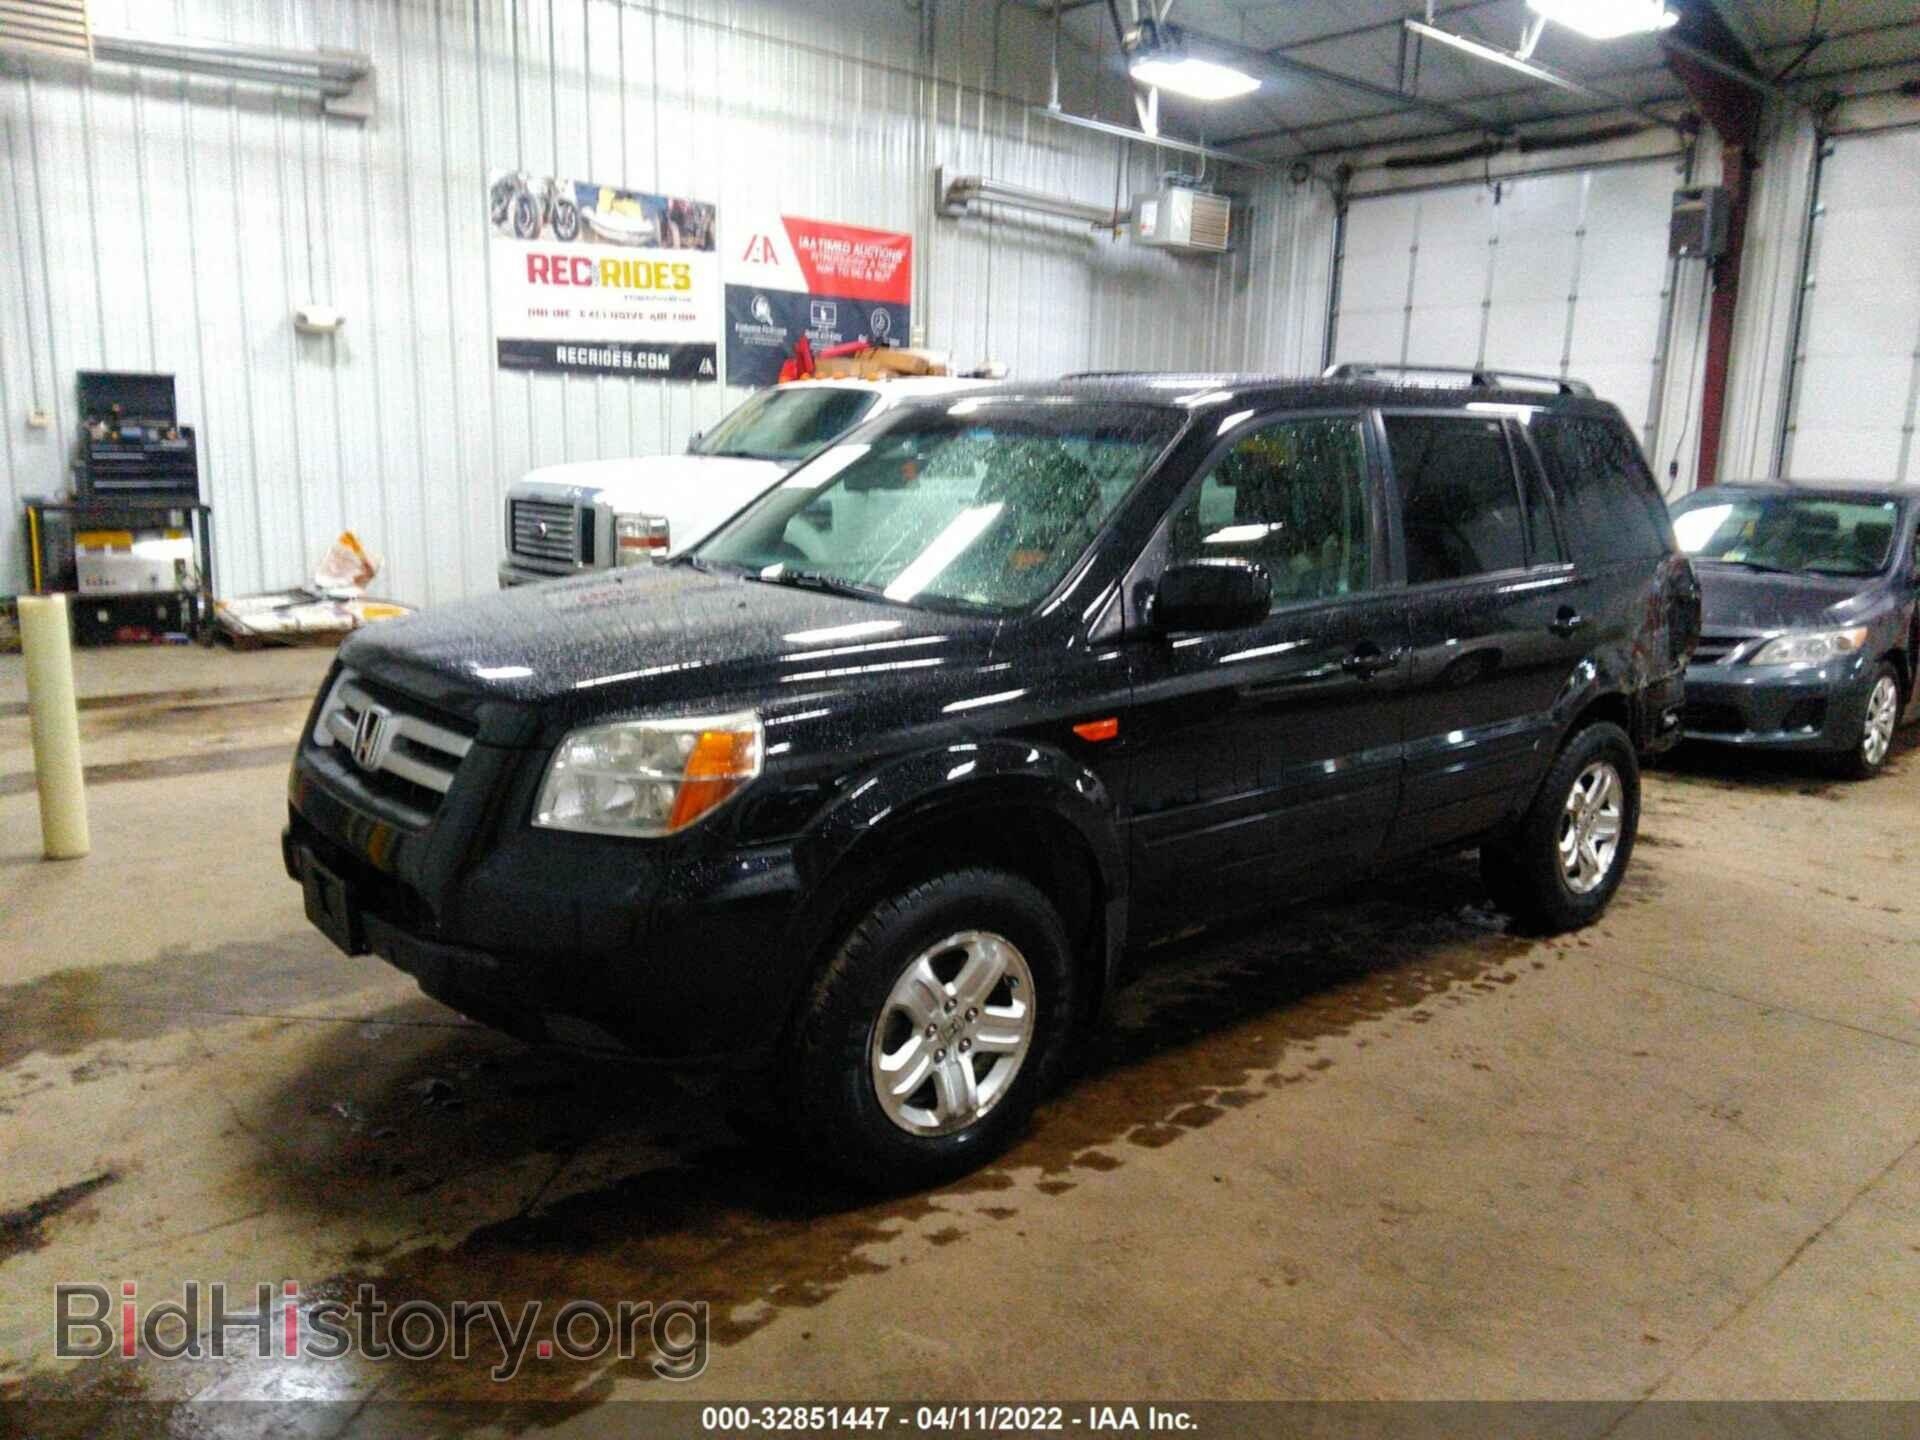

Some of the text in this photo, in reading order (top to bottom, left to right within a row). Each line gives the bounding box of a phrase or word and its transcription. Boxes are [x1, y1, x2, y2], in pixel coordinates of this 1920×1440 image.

[526, 253, 692, 290] REC RIDES
[556, 345, 671, 370] RECRIDES.COM
